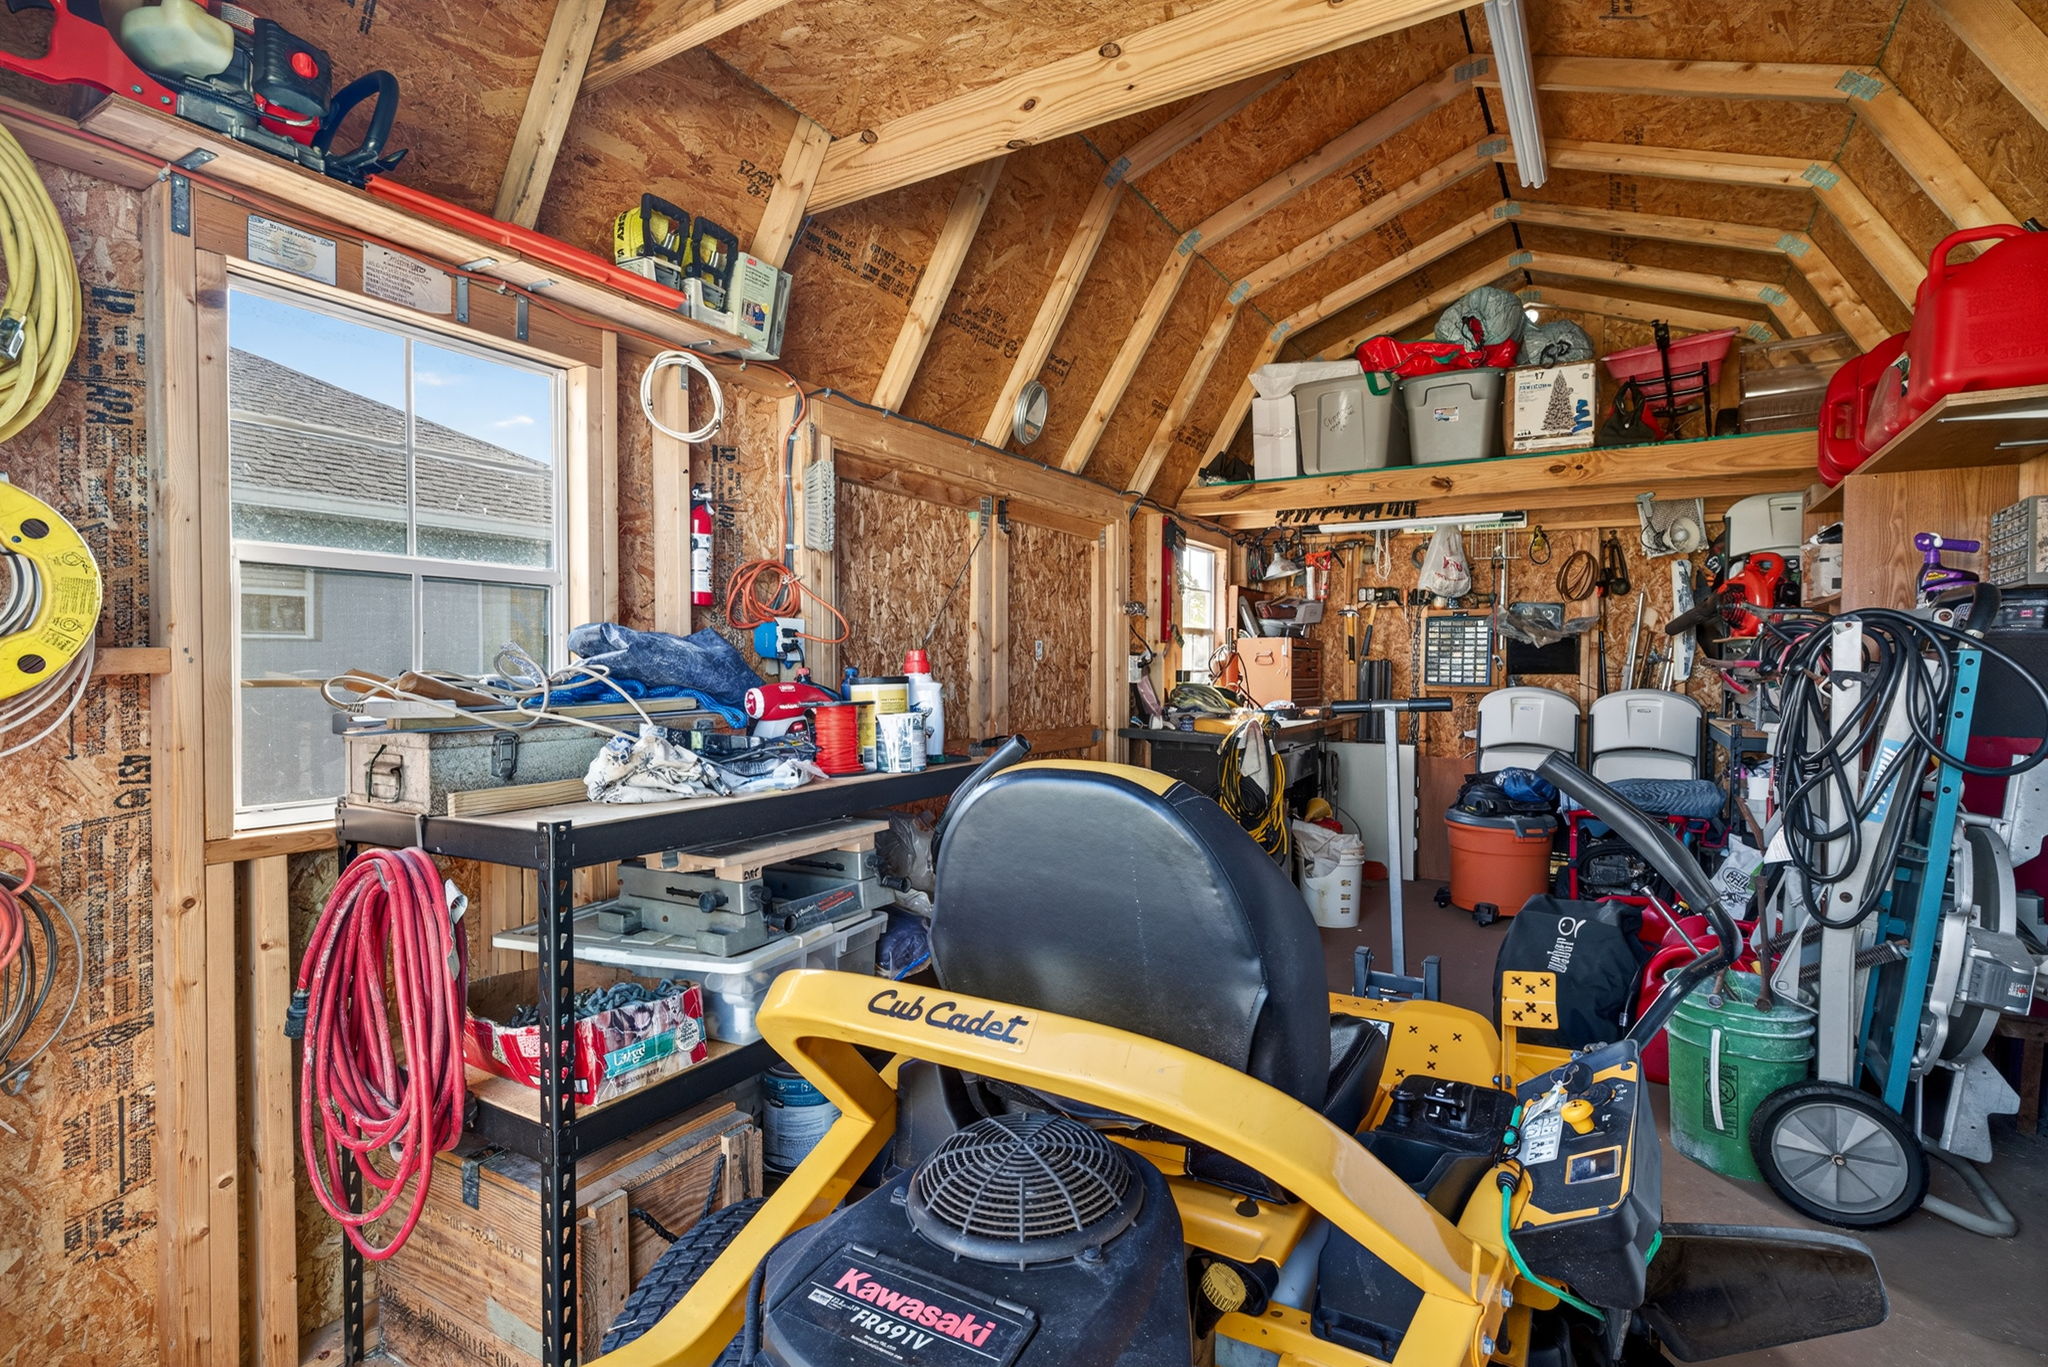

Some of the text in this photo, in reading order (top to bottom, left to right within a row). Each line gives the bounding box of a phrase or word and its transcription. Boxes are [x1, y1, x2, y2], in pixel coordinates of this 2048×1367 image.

[86, 382, 134, 426] APA
[1547, 936, 1575, 974] weber
[867, 989, 1029, 1044] Cub Cadet
[834, 1267, 997, 1347] Kawasaki
[850, 1309, 934, 1351] FR691V
